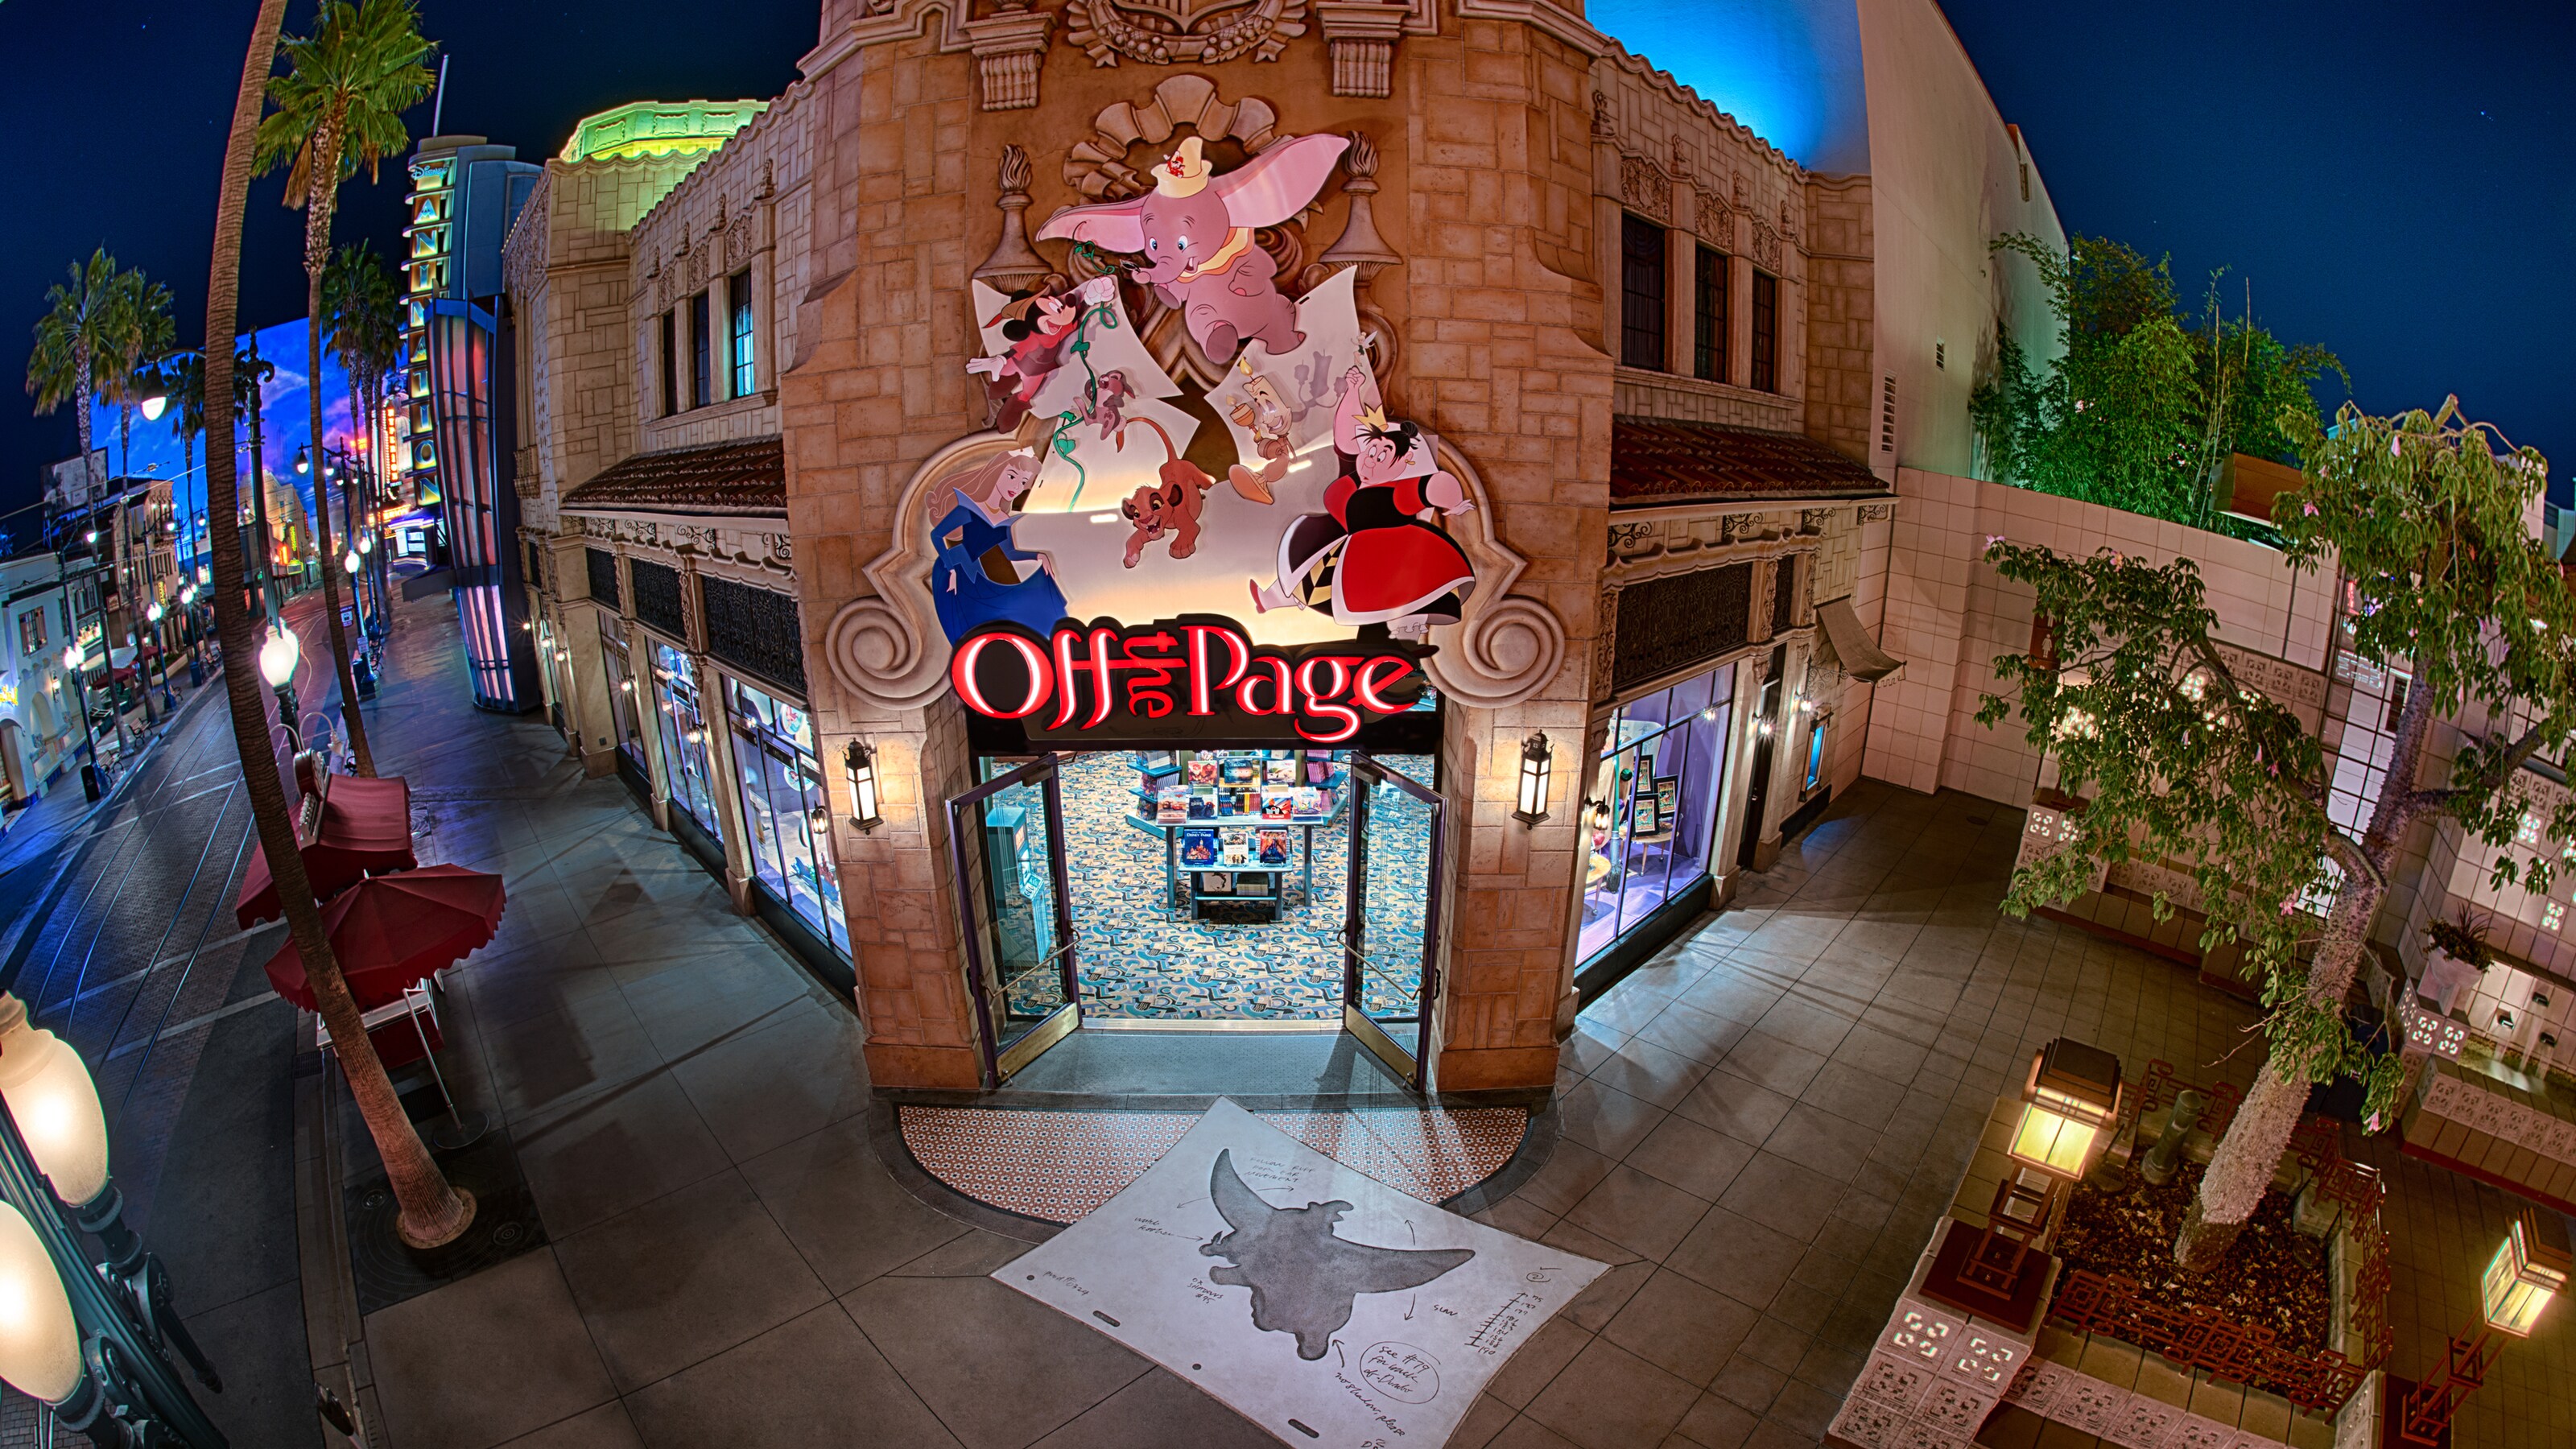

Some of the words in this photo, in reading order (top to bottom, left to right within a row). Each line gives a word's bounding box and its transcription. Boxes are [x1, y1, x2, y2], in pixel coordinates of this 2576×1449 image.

[1179, 625, 1416, 743] Page
[1245, 1171, 1298, 1183] MOVEMENT
[1478, 1346, 1496, 1356] 190
